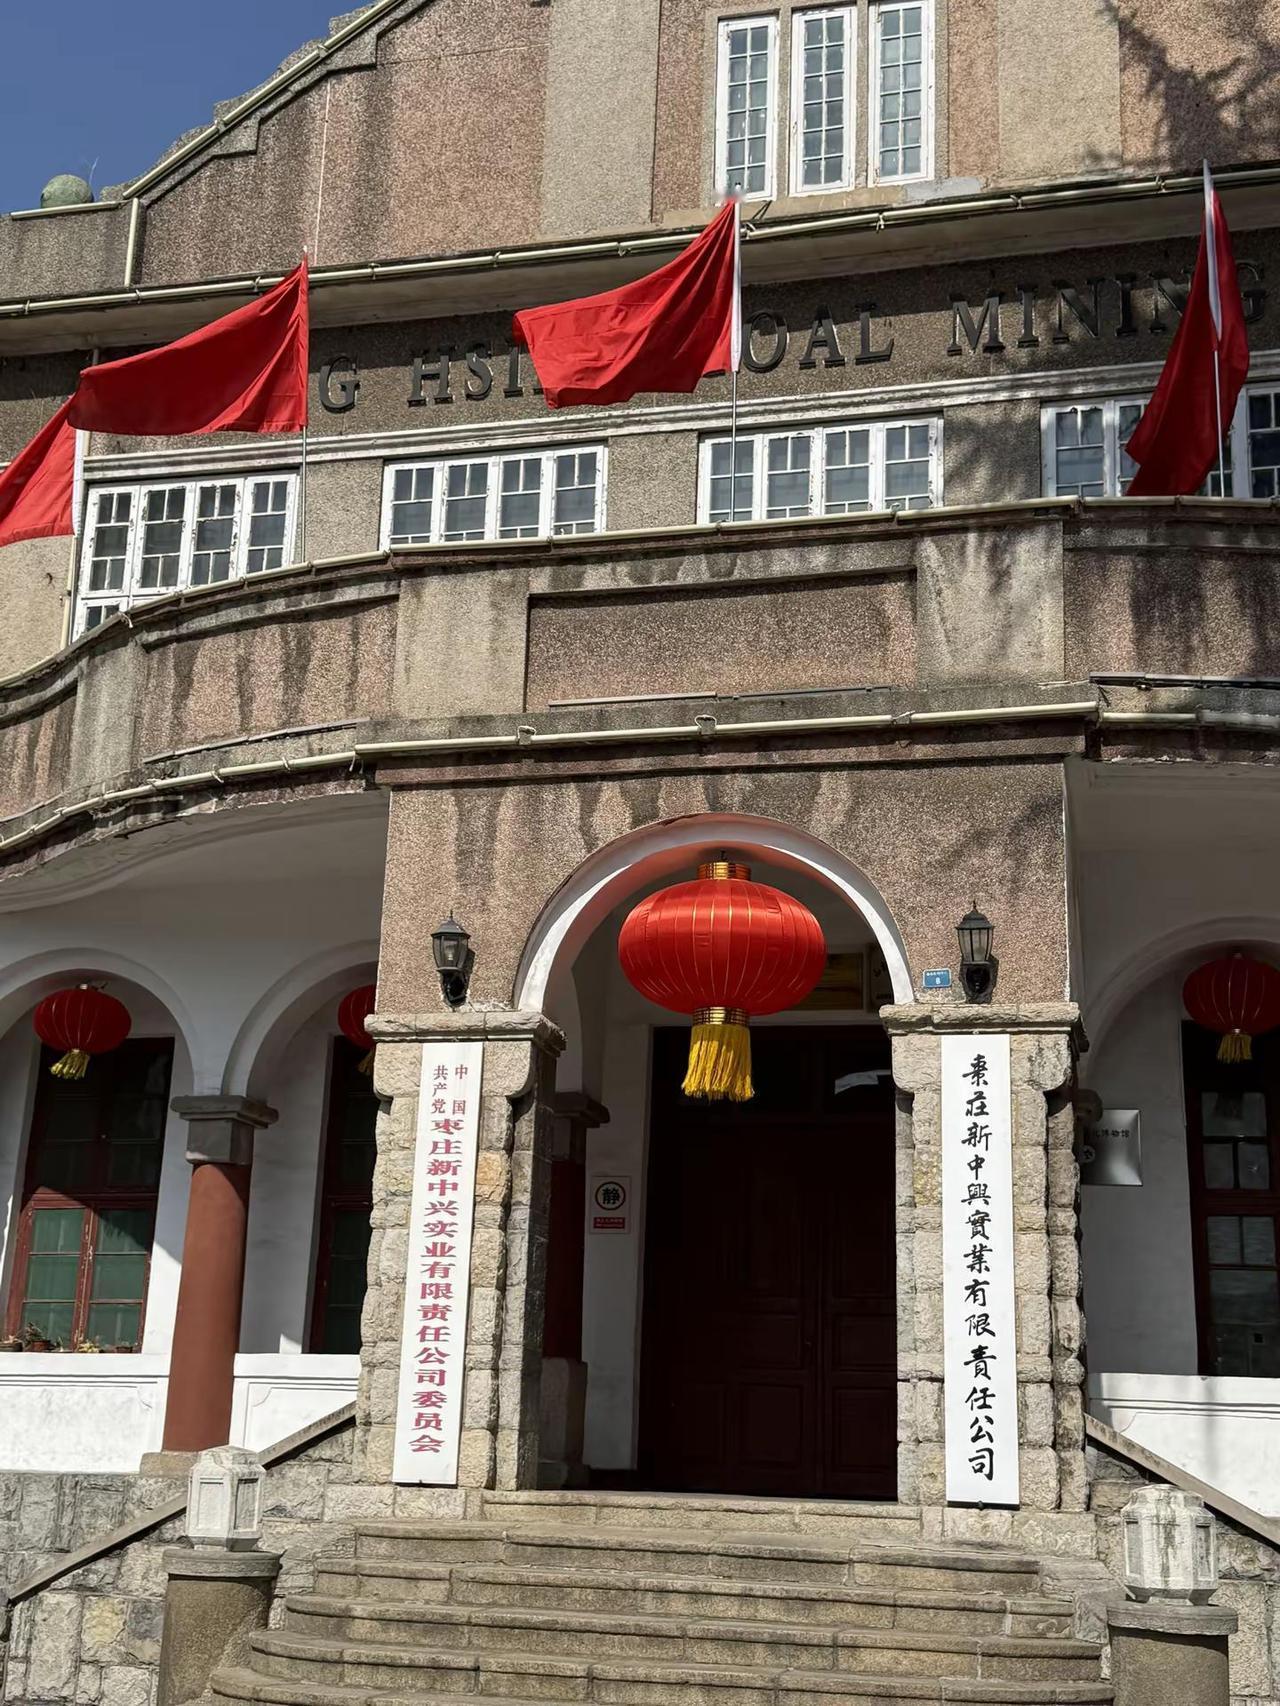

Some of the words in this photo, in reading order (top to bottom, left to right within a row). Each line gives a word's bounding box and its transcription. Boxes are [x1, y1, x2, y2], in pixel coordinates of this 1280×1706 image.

[407, 338, 546, 407] HSI
[702, 303, 895, 378] OAL
[409, 1118, 464, 1454] 枣庄新中兴实业有限责任公司委员会
